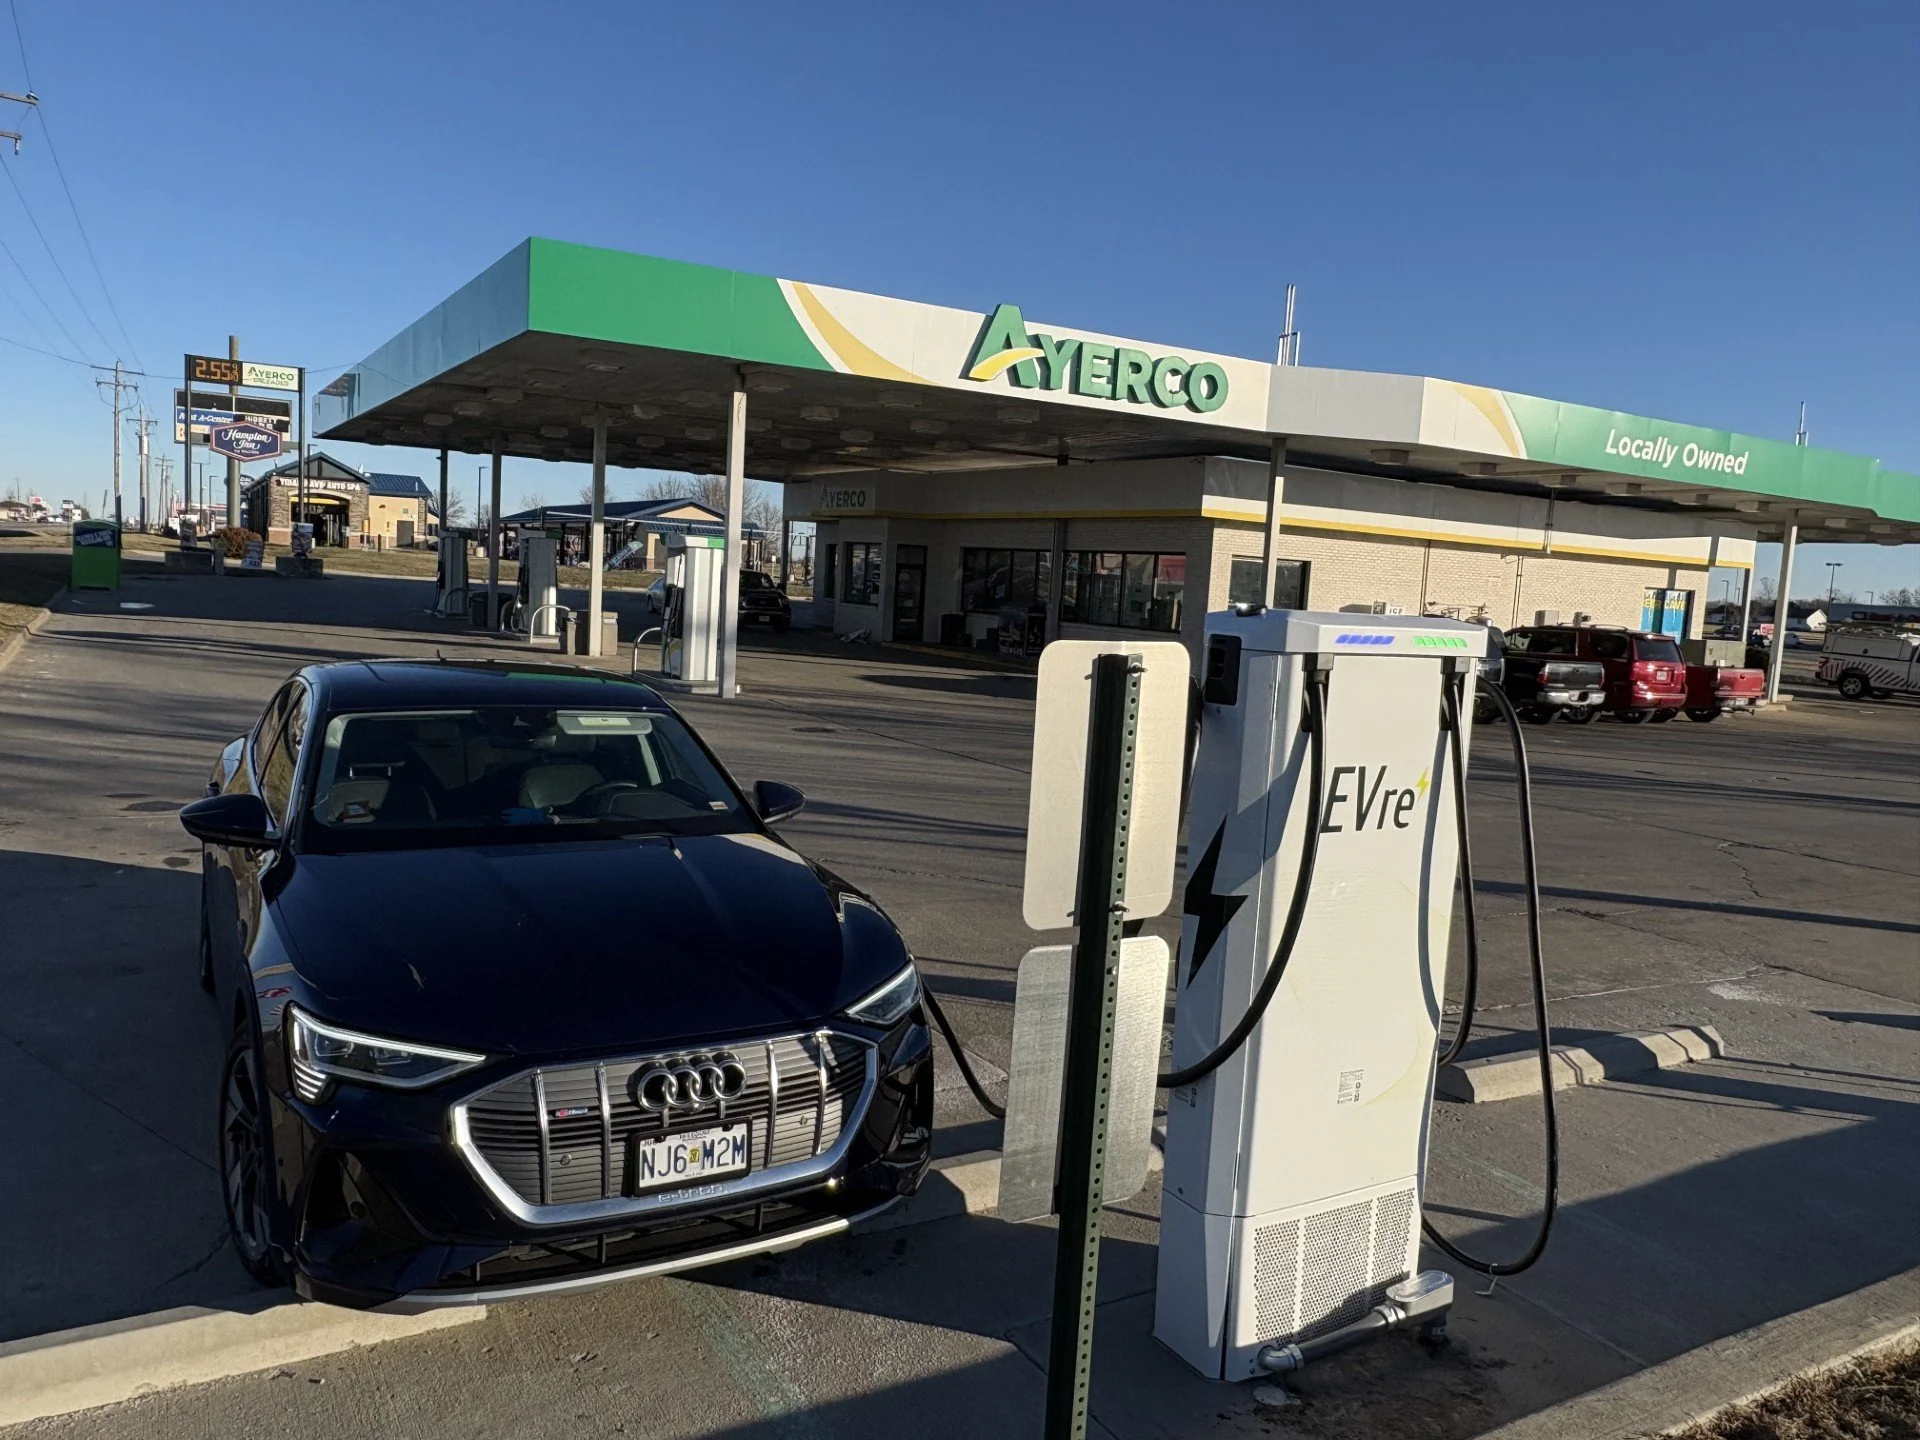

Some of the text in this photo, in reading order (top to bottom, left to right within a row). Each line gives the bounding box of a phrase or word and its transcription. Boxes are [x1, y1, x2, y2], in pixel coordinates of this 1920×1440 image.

[248, 366, 294, 381] AYERCO
[960, 304, 1228, 413] AYERCO
[222, 429, 272, 443] Hampton
[233, 440, 260, 450] Inn
[1605, 428, 1750, 475] Locally Owned
[818, 483, 866, 508] AYERCO
[1320, 764, 1415, 833] EVre
[641, 1144, 687, 1180] NJ6
[702, 1134, 746, 1170] M2M
